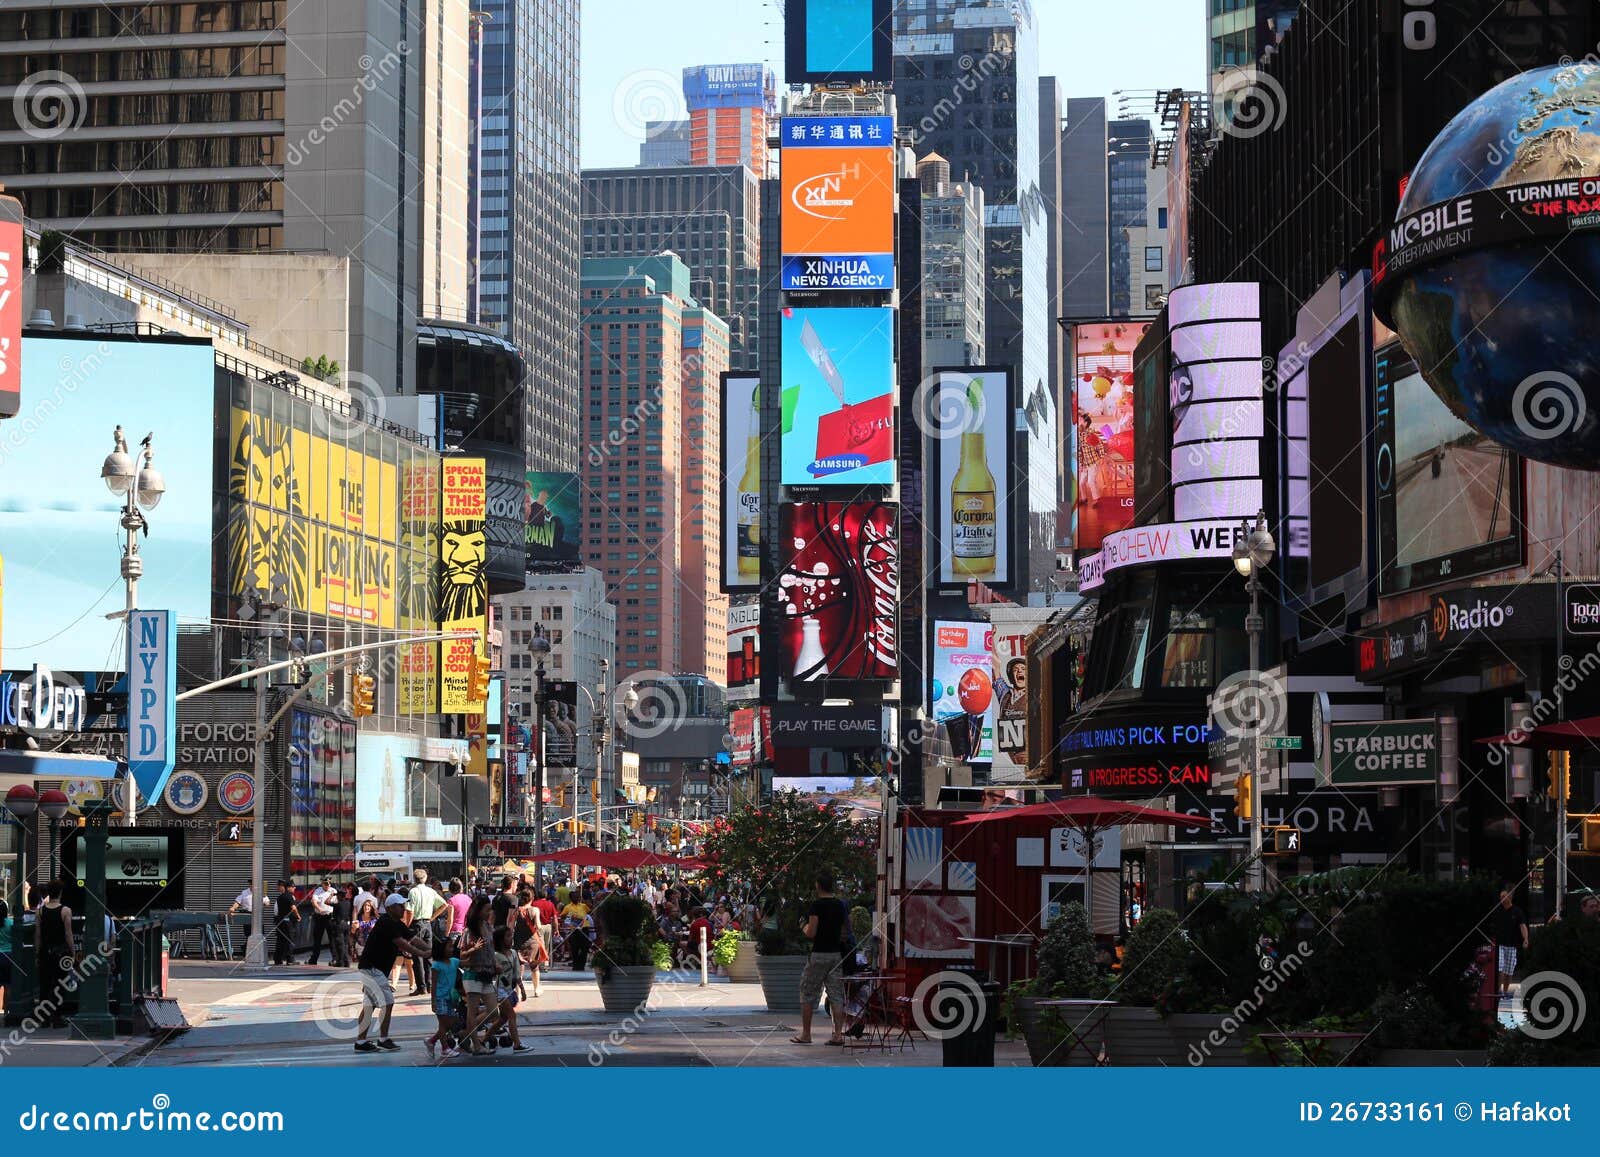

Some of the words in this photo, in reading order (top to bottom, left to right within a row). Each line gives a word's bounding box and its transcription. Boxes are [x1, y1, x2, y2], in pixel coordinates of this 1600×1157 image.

[791, 125, 882, 140] 新华通讯社
[1506, 184, 1552, 203] TURN
[1554, 182, 1579, 198] ME
[1390, 199, 1473, 253] MOBILE
[1391, 228, 1473, 271] ENTERTAINMENT
[806, 261, 870, 274] XINHUA
[791, 276, 828, 285] NEWS
[831, 275, 884, 286] AGENCY
[445, 466, 483, 475] SPECIAL
[815, 460, 861, 468] SAMSUNG
[447, 476, 456, 487] 8
[460, 476, 482, 487] PM
[339, 478, 362, 515] THE
[447, 495, 481, 507] THIS
[741, 493, 760, 507] Cor
[445, 508, 484, 516] SUNDAY
[954, 509, 993, 525] Corona
[1119, 529, 1171, 562] CHEW
[315, 513, 350, 589] LION
[353, 527, 390, 598] KING
[139, 616, 158, 757] NYPD
[34, 663, 87, 732] DEPT
[181, 723, 275, 742] FORCES
[779, 720, 808, 731] PLAY
[812, 720, 836, 731] THE
[839, 720, 876, 731] GAME
[1094, 728, 1126, 748] RYAN'S
[1129, 726, 1166, 744] PICK
[1333, 734, 1435, 753] STARBUCK
[180, 748, 259, 763] STATION
[1355, 753, 1427, 770] COFFEE
[1096, 766, 1163, 786] PROGRESS:
[1169, 764, 1208, 785] CAN
